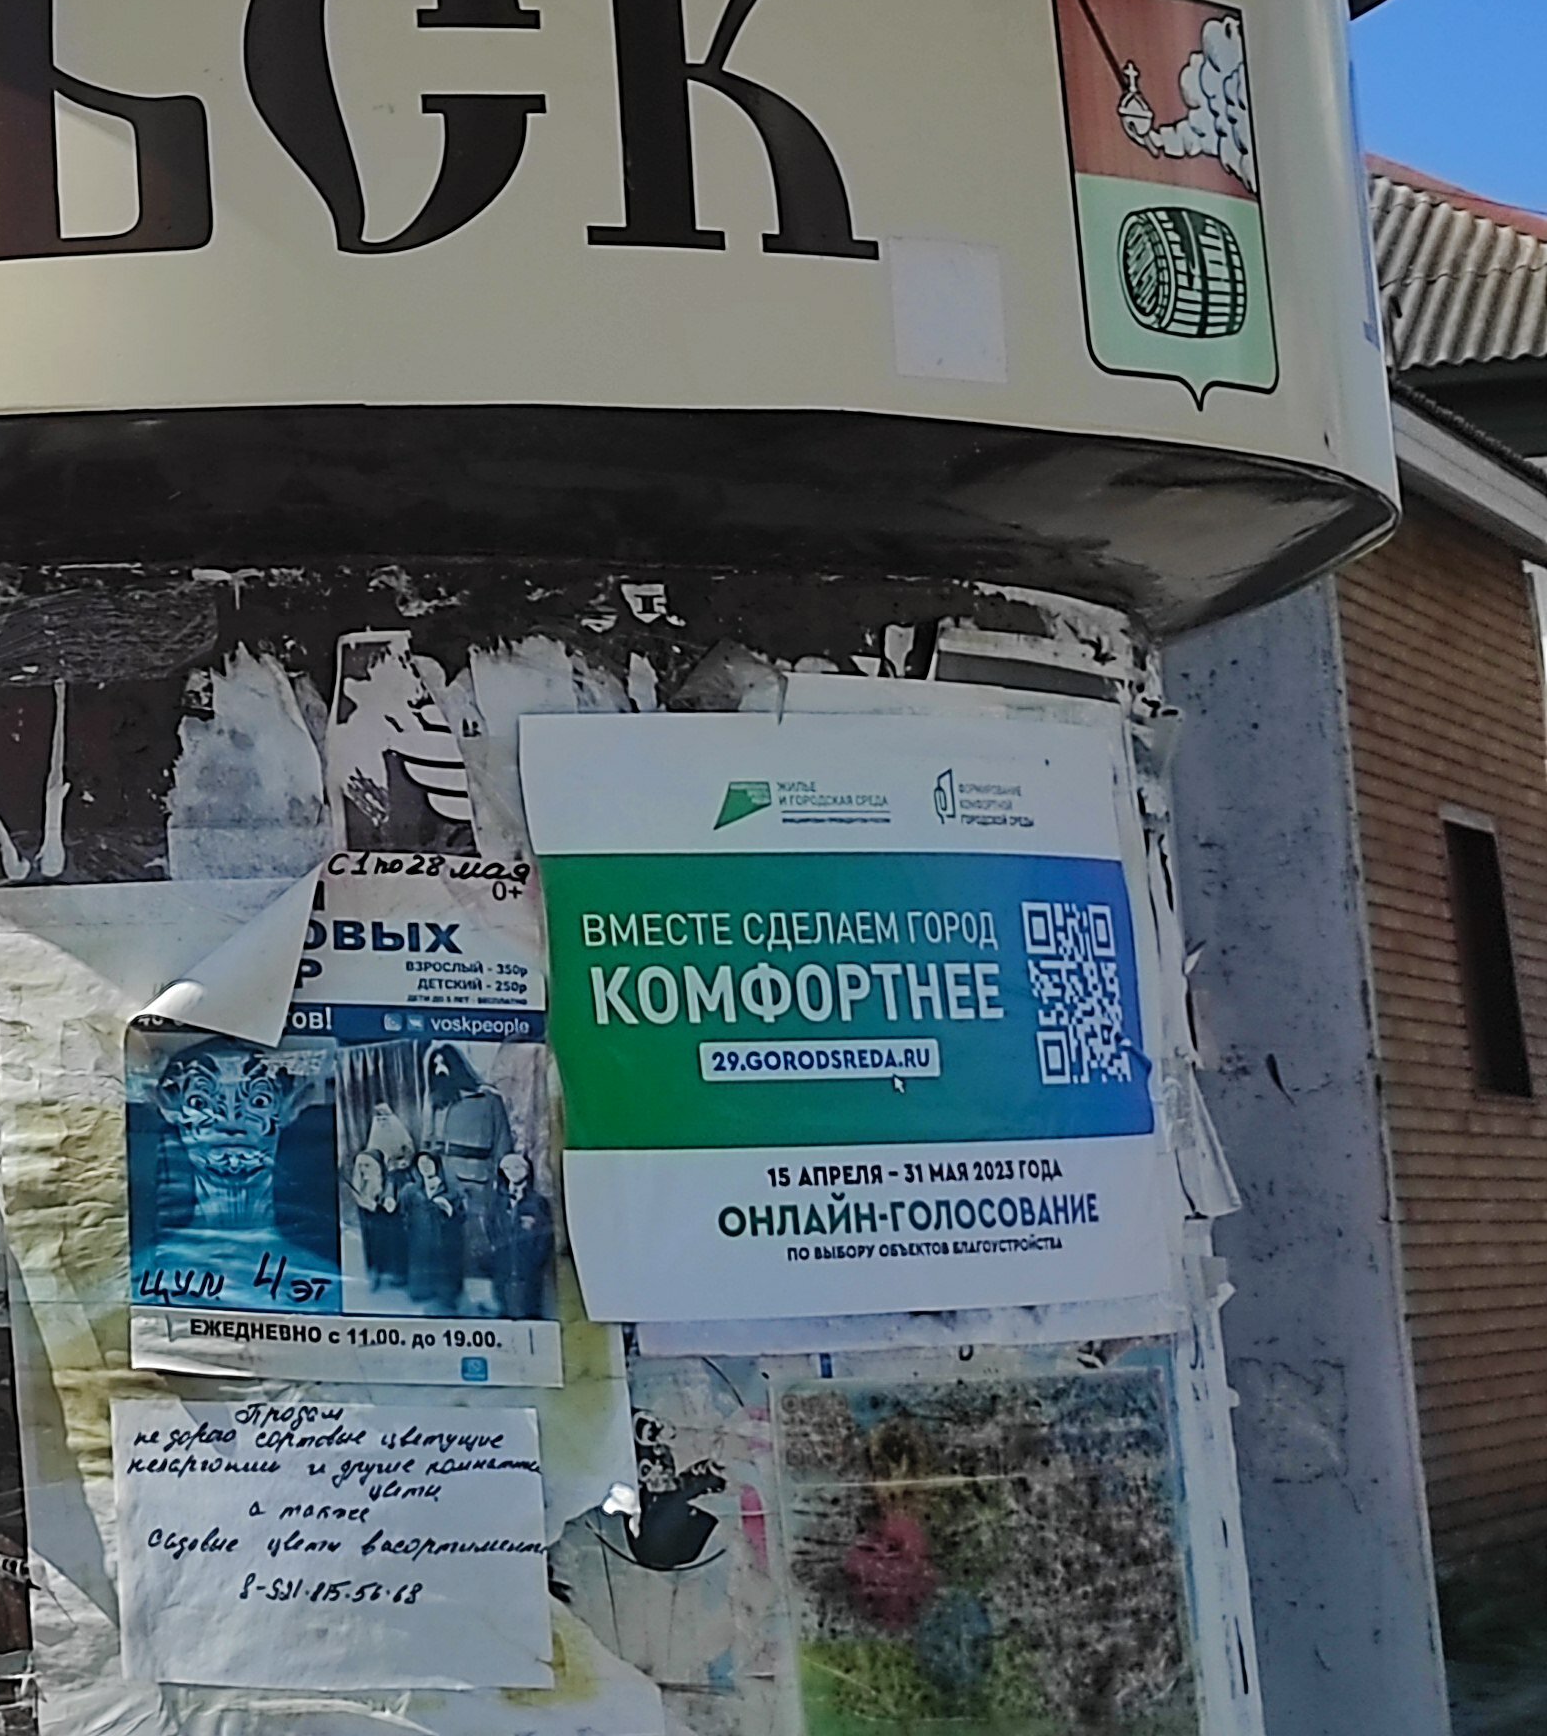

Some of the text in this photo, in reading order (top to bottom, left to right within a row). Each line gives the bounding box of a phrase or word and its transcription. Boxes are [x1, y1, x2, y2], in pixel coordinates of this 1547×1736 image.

[789, 795, 853, 806] ГОРОДСКАЯ
[855, 795, 889, 806] СРЕДА
[405, 854, 442, 876] 28
[448, 862, 531, 884] мая
[492, 881, 523, 902] 0+
[581, 910, 999, 952] ВМЕСТЕ СДЕЛАЕМ ГОРОД
[405, 960, 484, 974] ВЗРОСЛЫЙ
[417, 978, 483, 991] ДЕТСКИЙ
[589, 962, 1005, 1026] КОМФОРТНЕЕ
[430, 1015, 530, 1036] voskpeople
[711, 1048, 931, 1072] 29.GORODSREDA.RU
[767, 1167, 791, 1187] 15
[798, 1165, 883, 1186] АПРЕЛЯ
[904, 1163, 924, 1183] 31
[929, 1162, 969, 1182] МАЯ
[973, 1160, 1014, 1181] 2023
[1018, 1158, 1063, 1180] ГОДА
[717, 1190, 1100, 1238] ОНЛАЙН-ГОЛОСОВАНИЕ
[787, 1234, 1063, 1261] ПО ВЫБОРУ ОБЪЕКТОВ БЛАГОУСТРОЙСТВА
[253, 1251, 287, 1301] 4
[190, 1319, 322, 1344] ЕЖЕДНЕВНО
[327, 1331, 340, 1344] с
[411, 1332, 436, 1349] до
[443, 1330, 503, 1349] 19.00.
[235, 1403, 343, 1431] Продам
[381, 1426, 504, 1453] цветущие
[307, 1463, 326, 1476] и
[332, 1458, 415, 1488] другие
